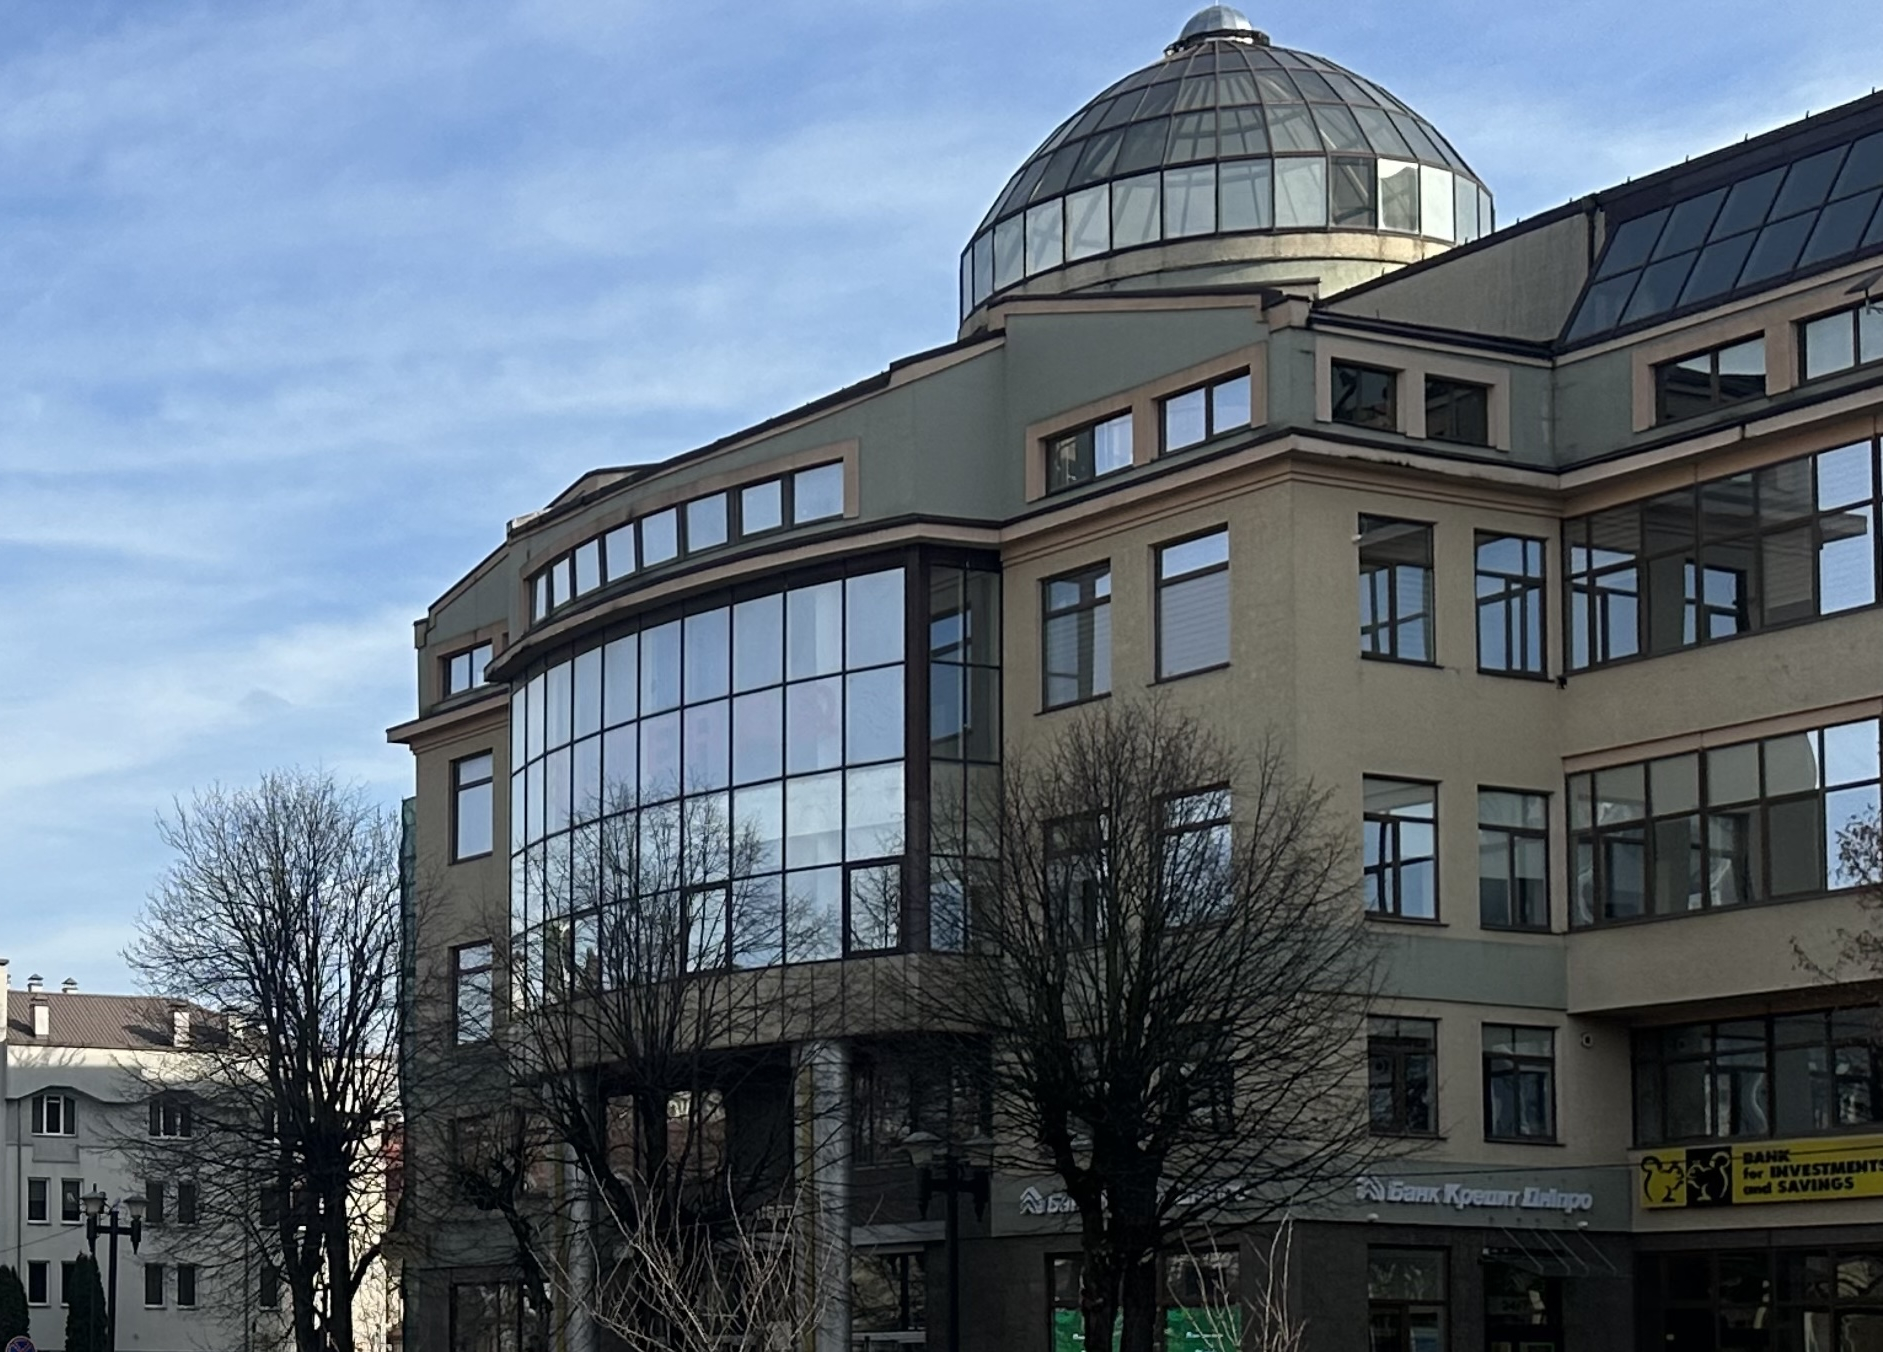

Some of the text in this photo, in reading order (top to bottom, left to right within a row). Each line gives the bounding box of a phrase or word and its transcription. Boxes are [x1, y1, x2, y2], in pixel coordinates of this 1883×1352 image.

[1743, 1150, 1790, 1164] BANK
[1743, 1167, 1764, 1180] for
[1743, 1176, 1855, 1195] and SAVINGS
[1386, 1180, 1441, 1204] Банк
[1521, 1187, 1594, 1213] Дніпро
